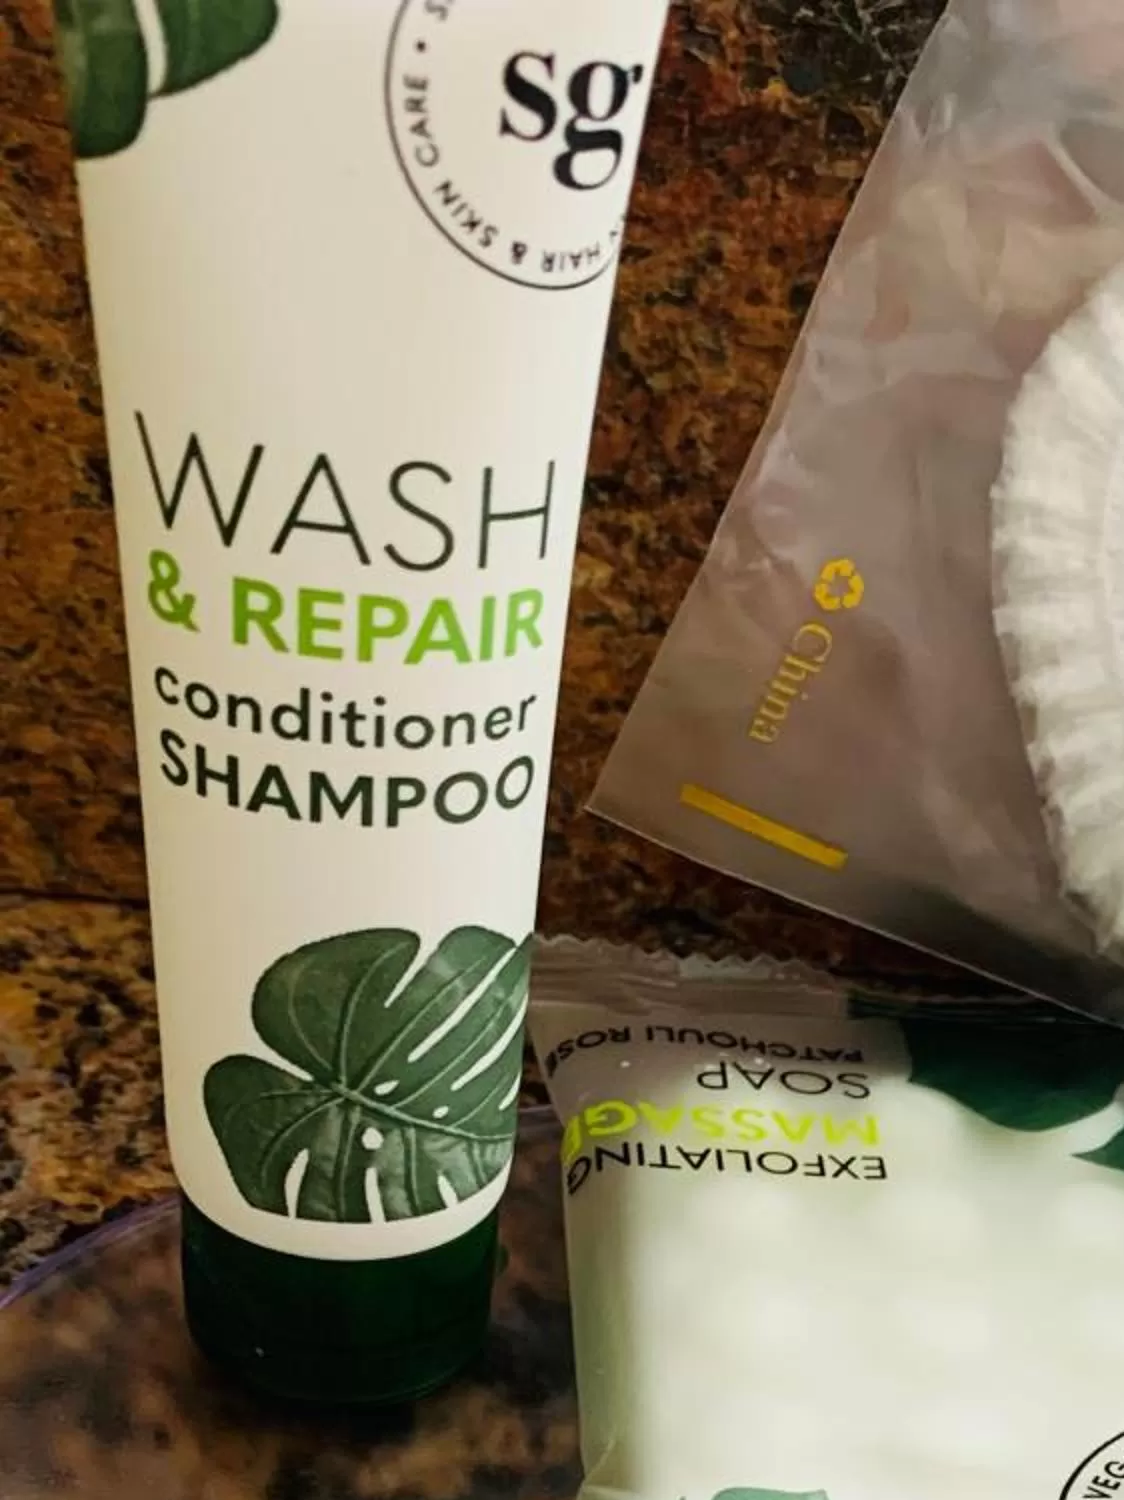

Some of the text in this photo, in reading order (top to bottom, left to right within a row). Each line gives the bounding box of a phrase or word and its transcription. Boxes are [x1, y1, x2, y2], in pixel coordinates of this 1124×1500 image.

[403, 74, 602, 273] HAIR & SKIN CARE
[497, 50, 644, 191] sg
[135, 410, 556, 572] WASH
[147, 550, 544, 666] & REPAIR
[154, 667, 538, 750] conditioner
[748, 622, 834, 744] China
[160, 728, 536, 829] SHAMPOO
[645, 1025, 866, 1063] PATCHOULI
[696, 1060, 872, 1100] SOAP
[566, 1141, 889, 1196] EXFOLIATING
